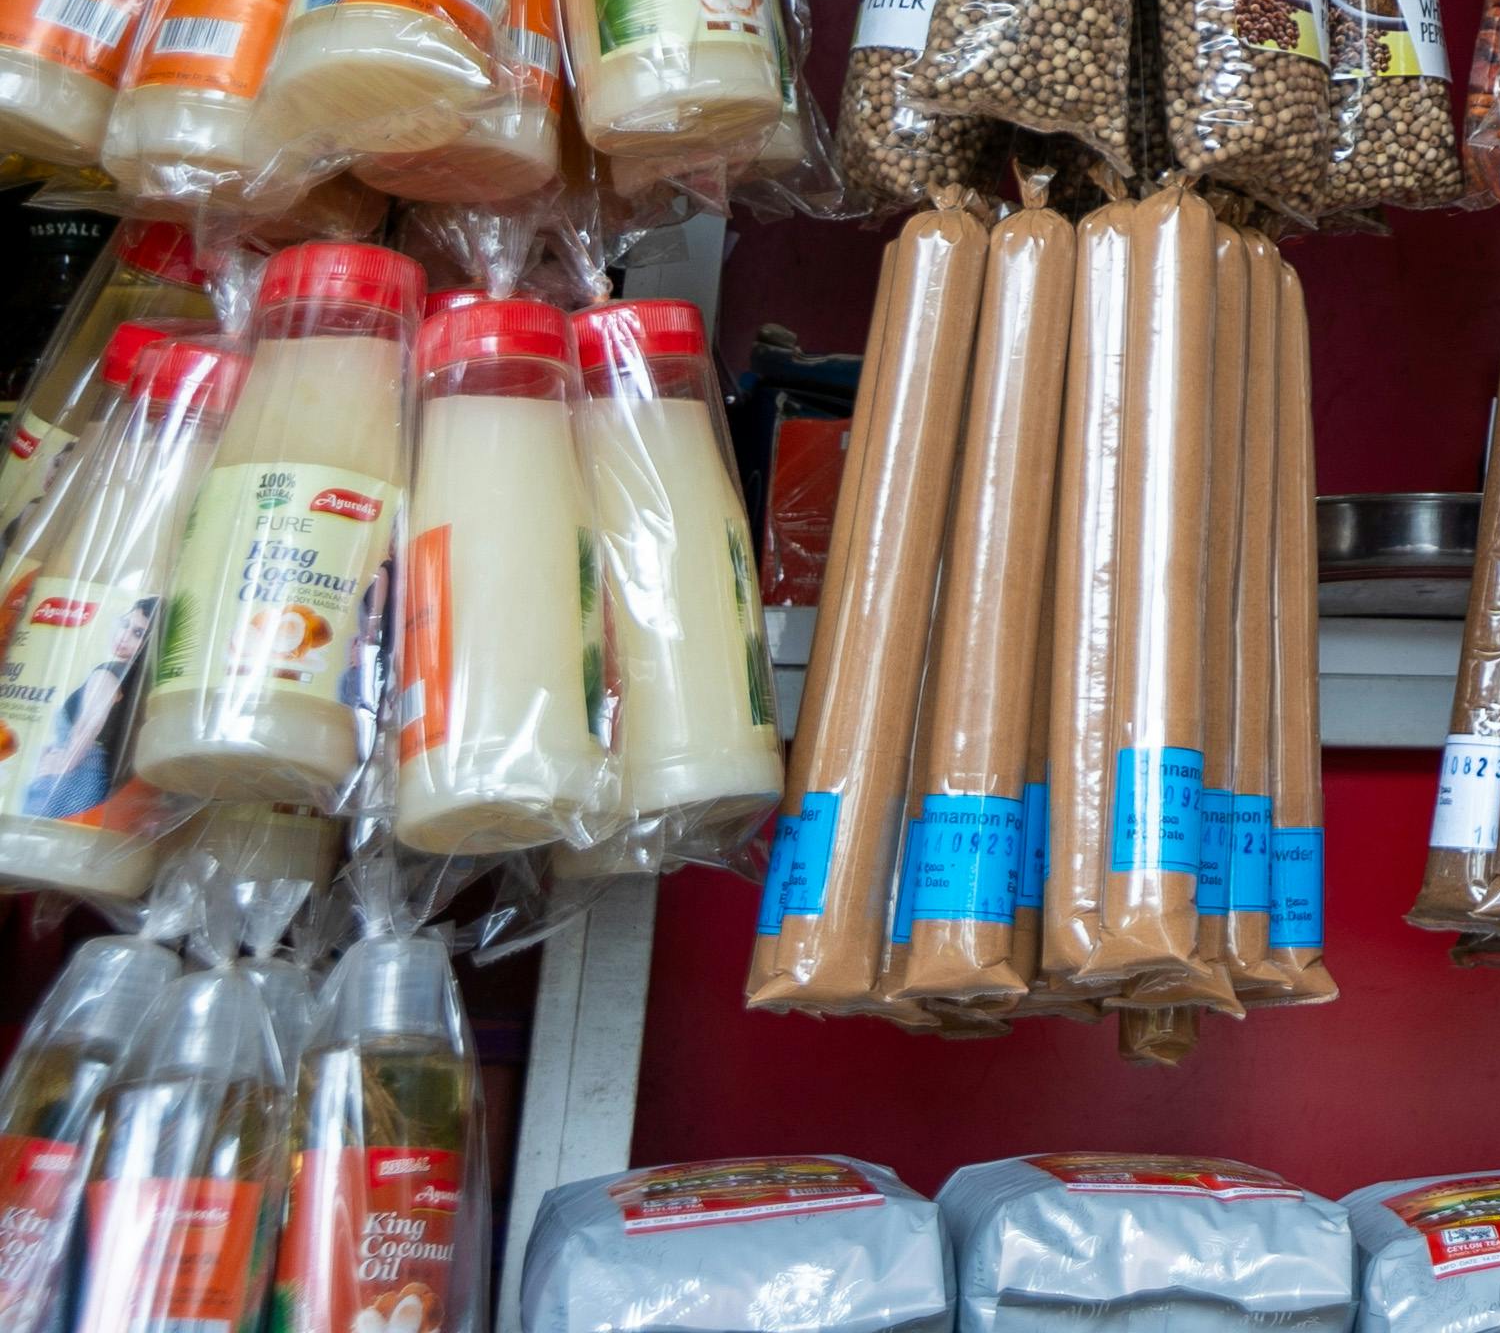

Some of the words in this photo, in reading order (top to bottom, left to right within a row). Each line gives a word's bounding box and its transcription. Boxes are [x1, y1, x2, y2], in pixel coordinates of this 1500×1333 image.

[258, 474, 296, 489] 100%
[256, 487, 294, 503] NATURAL
[313, 492, 377, 517] Ayuredic
[256, 516, 314, 533] PURE
[245, 540, 319, 567] King
[242, 560, 357, 594] Coconut
[238, 582, 283, 603] Oil
[364, 1212, 427, 1241] King
[359, 1237, 457, 1261] Coconut
[1446, 1242, 1483, 1254] CEYLON
[357, 1257, 400, 1282] Oil
